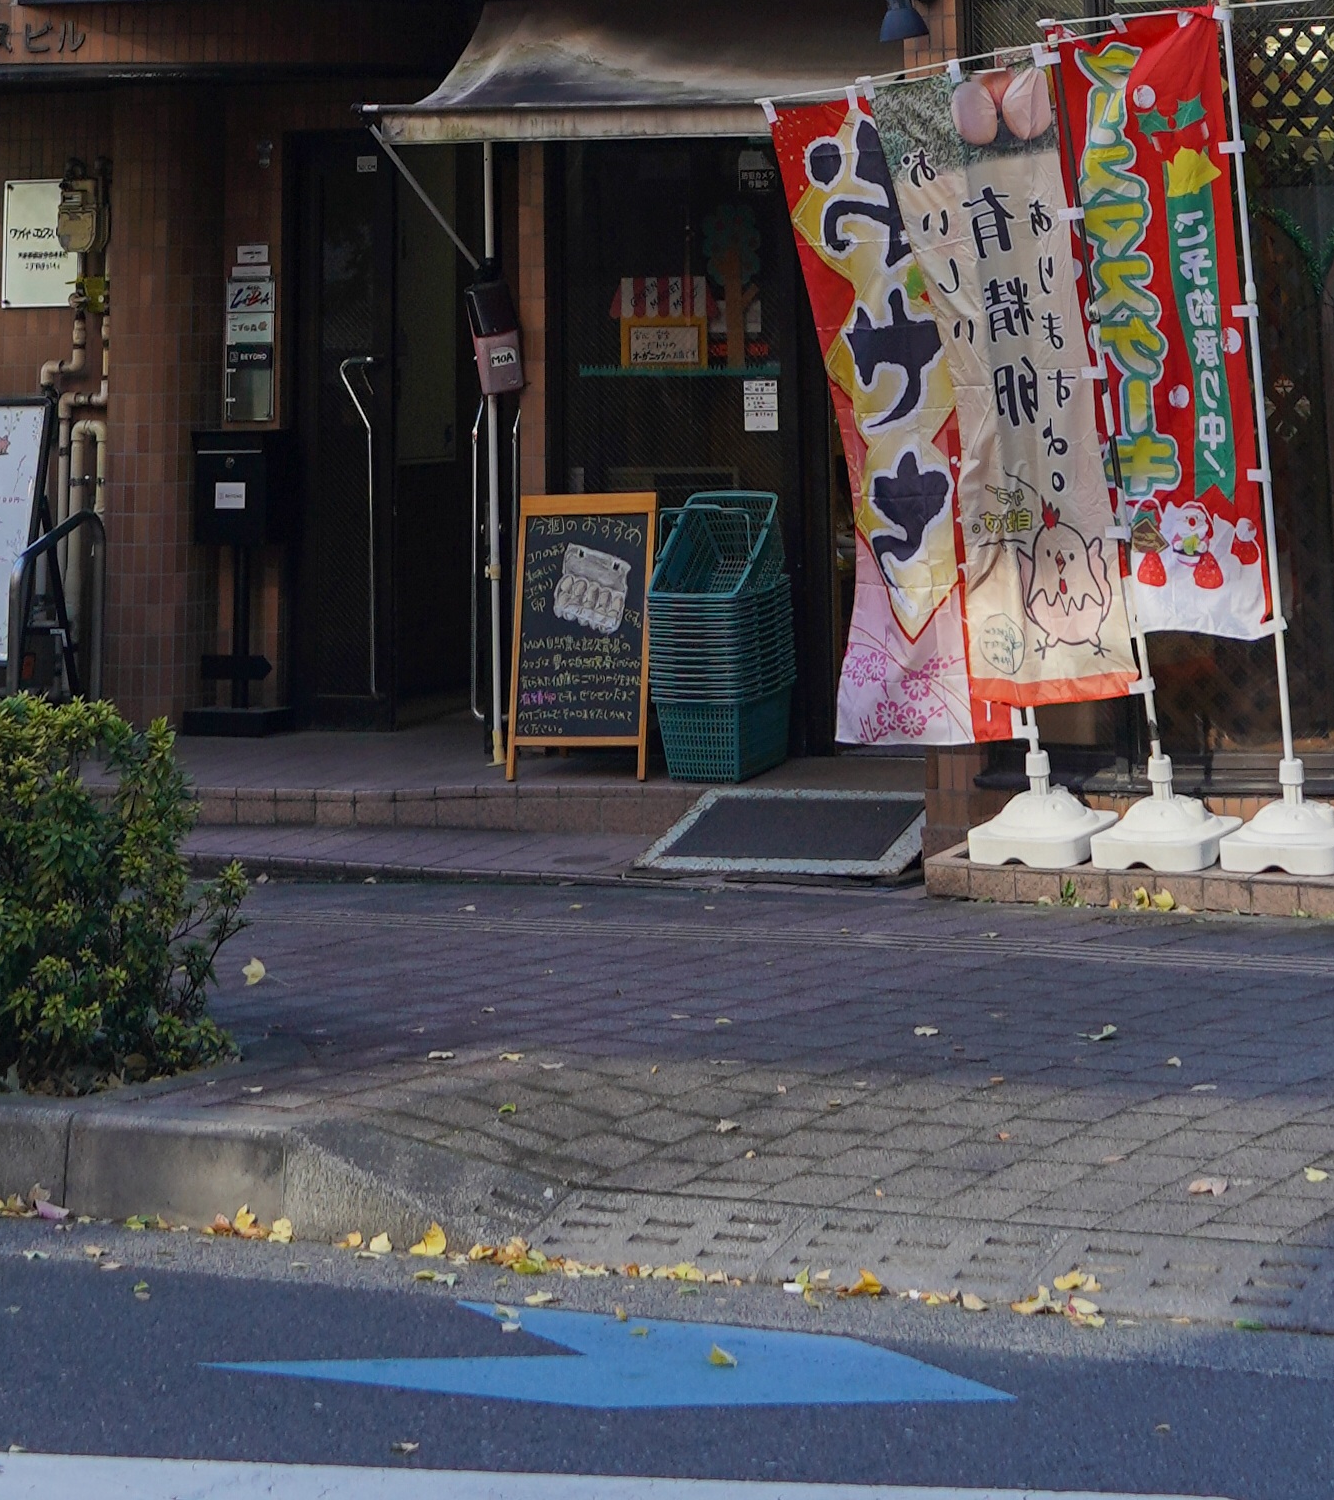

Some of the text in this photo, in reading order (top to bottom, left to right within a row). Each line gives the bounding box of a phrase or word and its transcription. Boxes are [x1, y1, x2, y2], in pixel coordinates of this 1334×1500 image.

[240, 352, 268, 361] BEYOND
[491, 352, 514, 365] MOA
[529, 515, 642, 547] 今週のおすすめ
